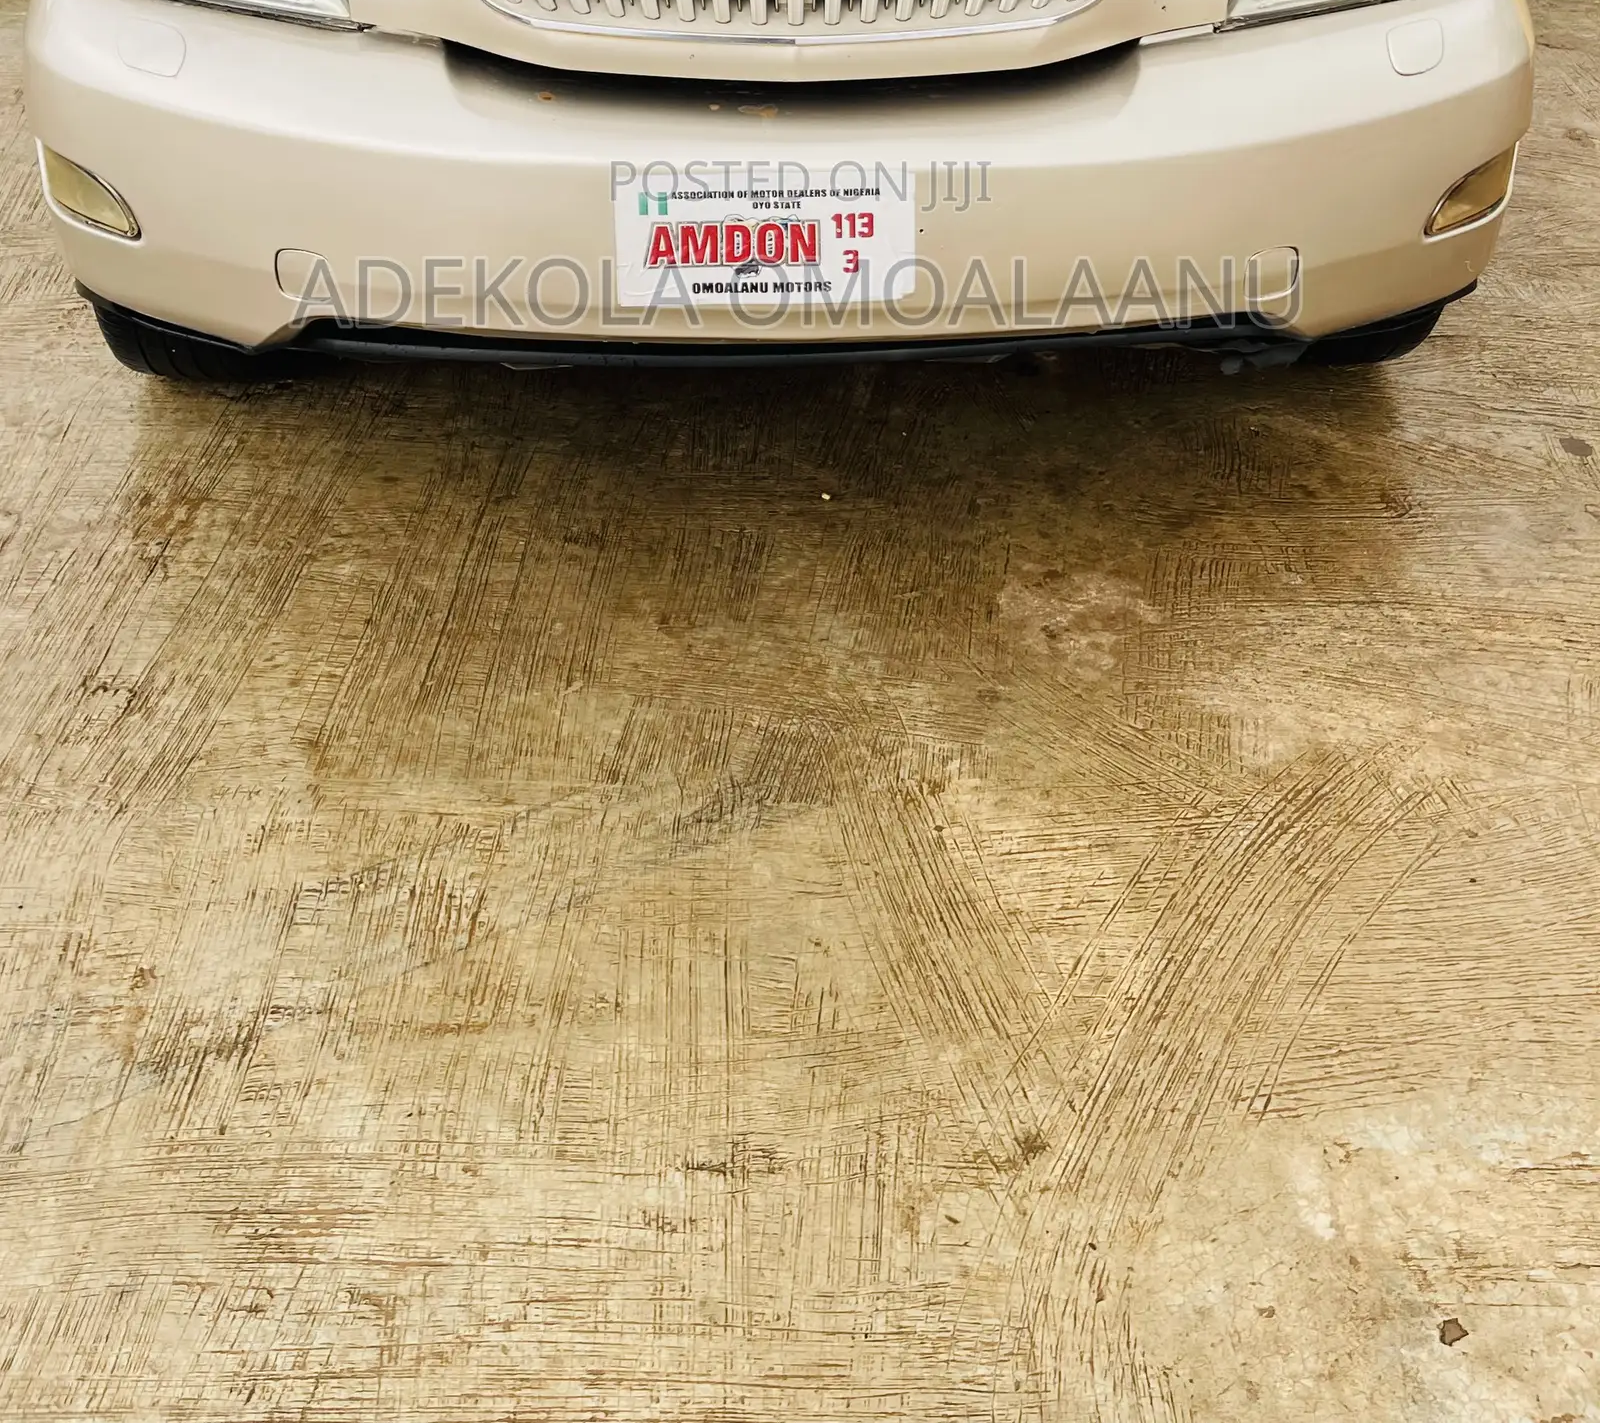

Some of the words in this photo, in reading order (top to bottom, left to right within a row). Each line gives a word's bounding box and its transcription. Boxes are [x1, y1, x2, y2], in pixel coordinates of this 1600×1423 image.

[671, 190, 735, 199] ASSOCIATION
[737, 190, 749, 199] OF
[750, 189, 785, 198] MOTOR
[787, 189, 827, 198] DEALERS
[829, 189, 841, 197] OF
[843, 188, 880, 196] NIGERIA
[752, 201, 771, 209] OYO
[773, 201, 801, 209] STATE
[831, 212, 875, 239] 113
[646, 221, 820, 267] AMDON
[842, 249, 859, 274] 3
[692, 282, 769, 294] OMOALANU
[772, 281, 832, 293] MOTORS
